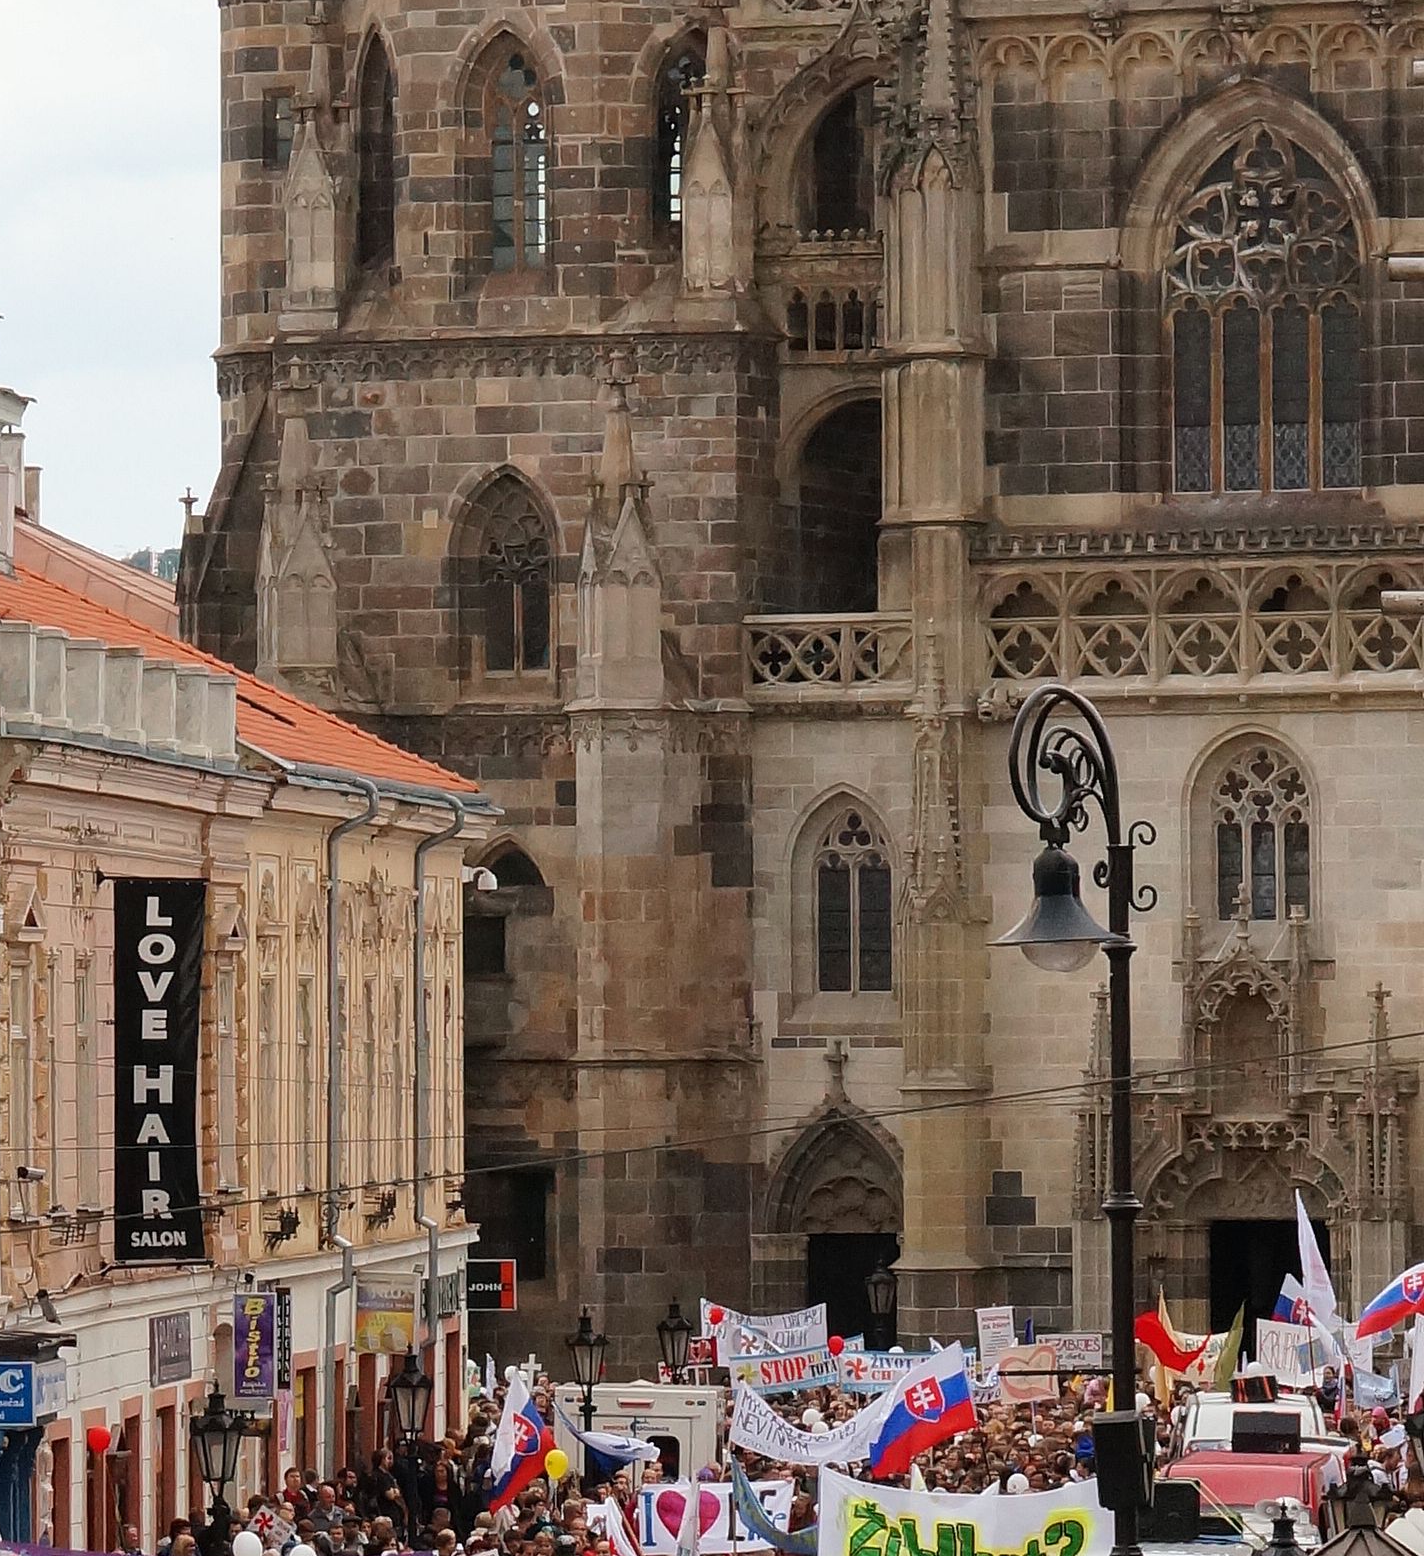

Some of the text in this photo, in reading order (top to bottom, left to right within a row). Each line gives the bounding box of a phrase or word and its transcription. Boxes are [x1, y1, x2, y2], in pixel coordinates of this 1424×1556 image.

[133, 896, 176, 1220] LOVE HAIR
[131, 1231, 186, 1247] SALON
[244, 1297, 267, 1378] Bistro
[760, 1355, 806, 1384] STOP
[640, 1491, 657, 1547] I
